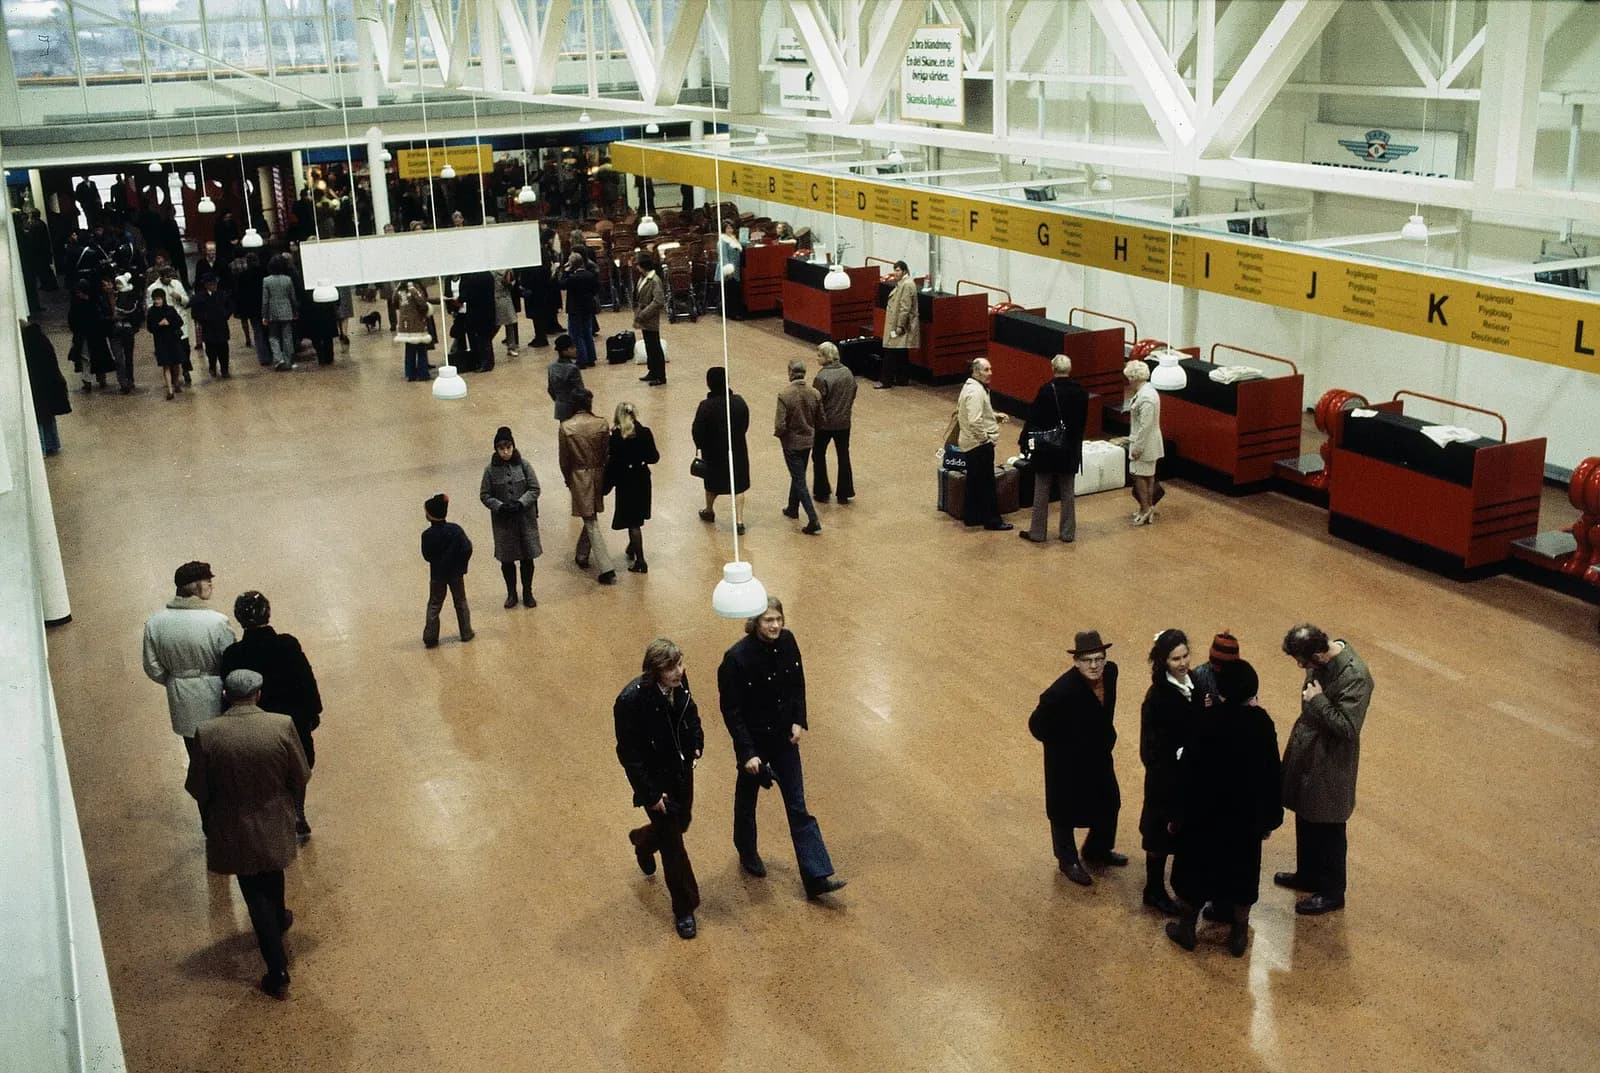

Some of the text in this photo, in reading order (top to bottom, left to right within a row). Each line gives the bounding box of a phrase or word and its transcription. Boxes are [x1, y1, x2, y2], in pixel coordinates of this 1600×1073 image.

[731, 170, 738, 187] A
[769, 176, 776, 193] B
[811, 183, 819, 202] C
[858, 191, 867, 210] D
[911, 200, 919, 221] E
[970, 210, 979, 232] F
[1037, 223, 1050, 247] G
[1114, 235, 1128, 262] H
[1205, 251, 1210, 279] I
[1306, 271, 1317, 299] J
[1427, 292, 1450, 326] K
[1574, 320, 1595, 356] L
[945, 457, 966, 467] adida
